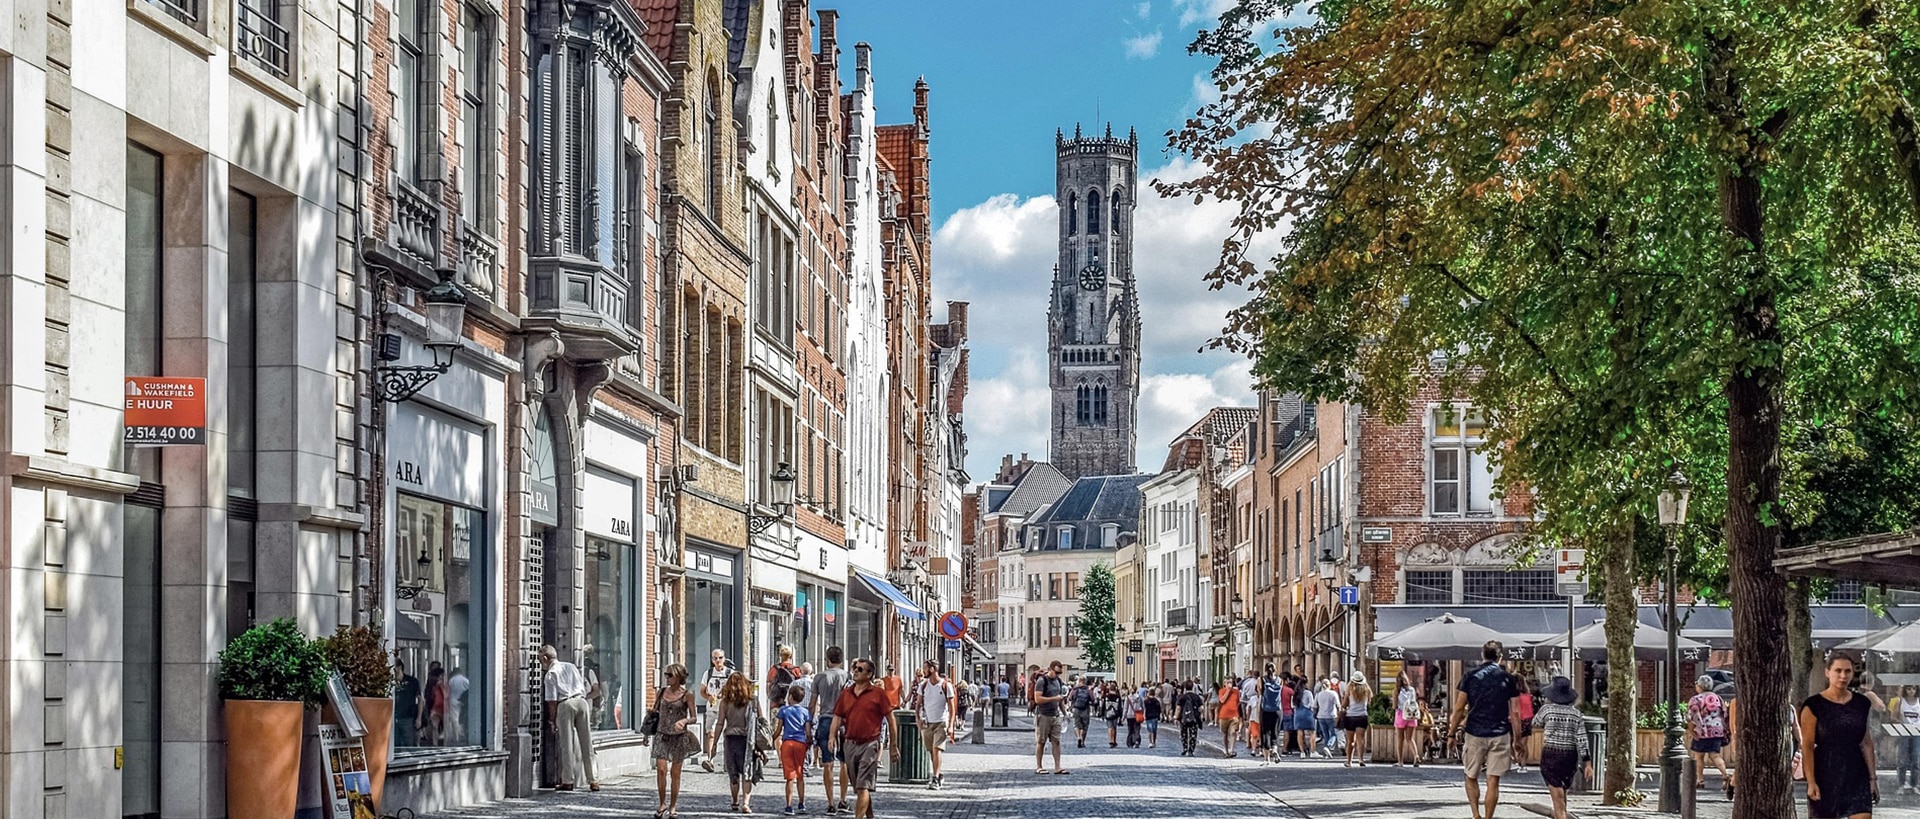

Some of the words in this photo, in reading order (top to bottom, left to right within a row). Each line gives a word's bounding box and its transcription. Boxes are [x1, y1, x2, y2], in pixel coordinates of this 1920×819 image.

[126, 399, 134, 409] E
[137, 399, 173, 409] HUUR
[125, 426, 134, 438] 2
[137, 427, 157, 439] 514
[159, 427, 176, 439] 40
[179, 427, 196, 439] 00
[395, 459, 423, 486] ARA
[530, 490, 549, 512] ARA
[611, 517, 631, 536] ZARA
[698, 557, 709, 568] ZARA
